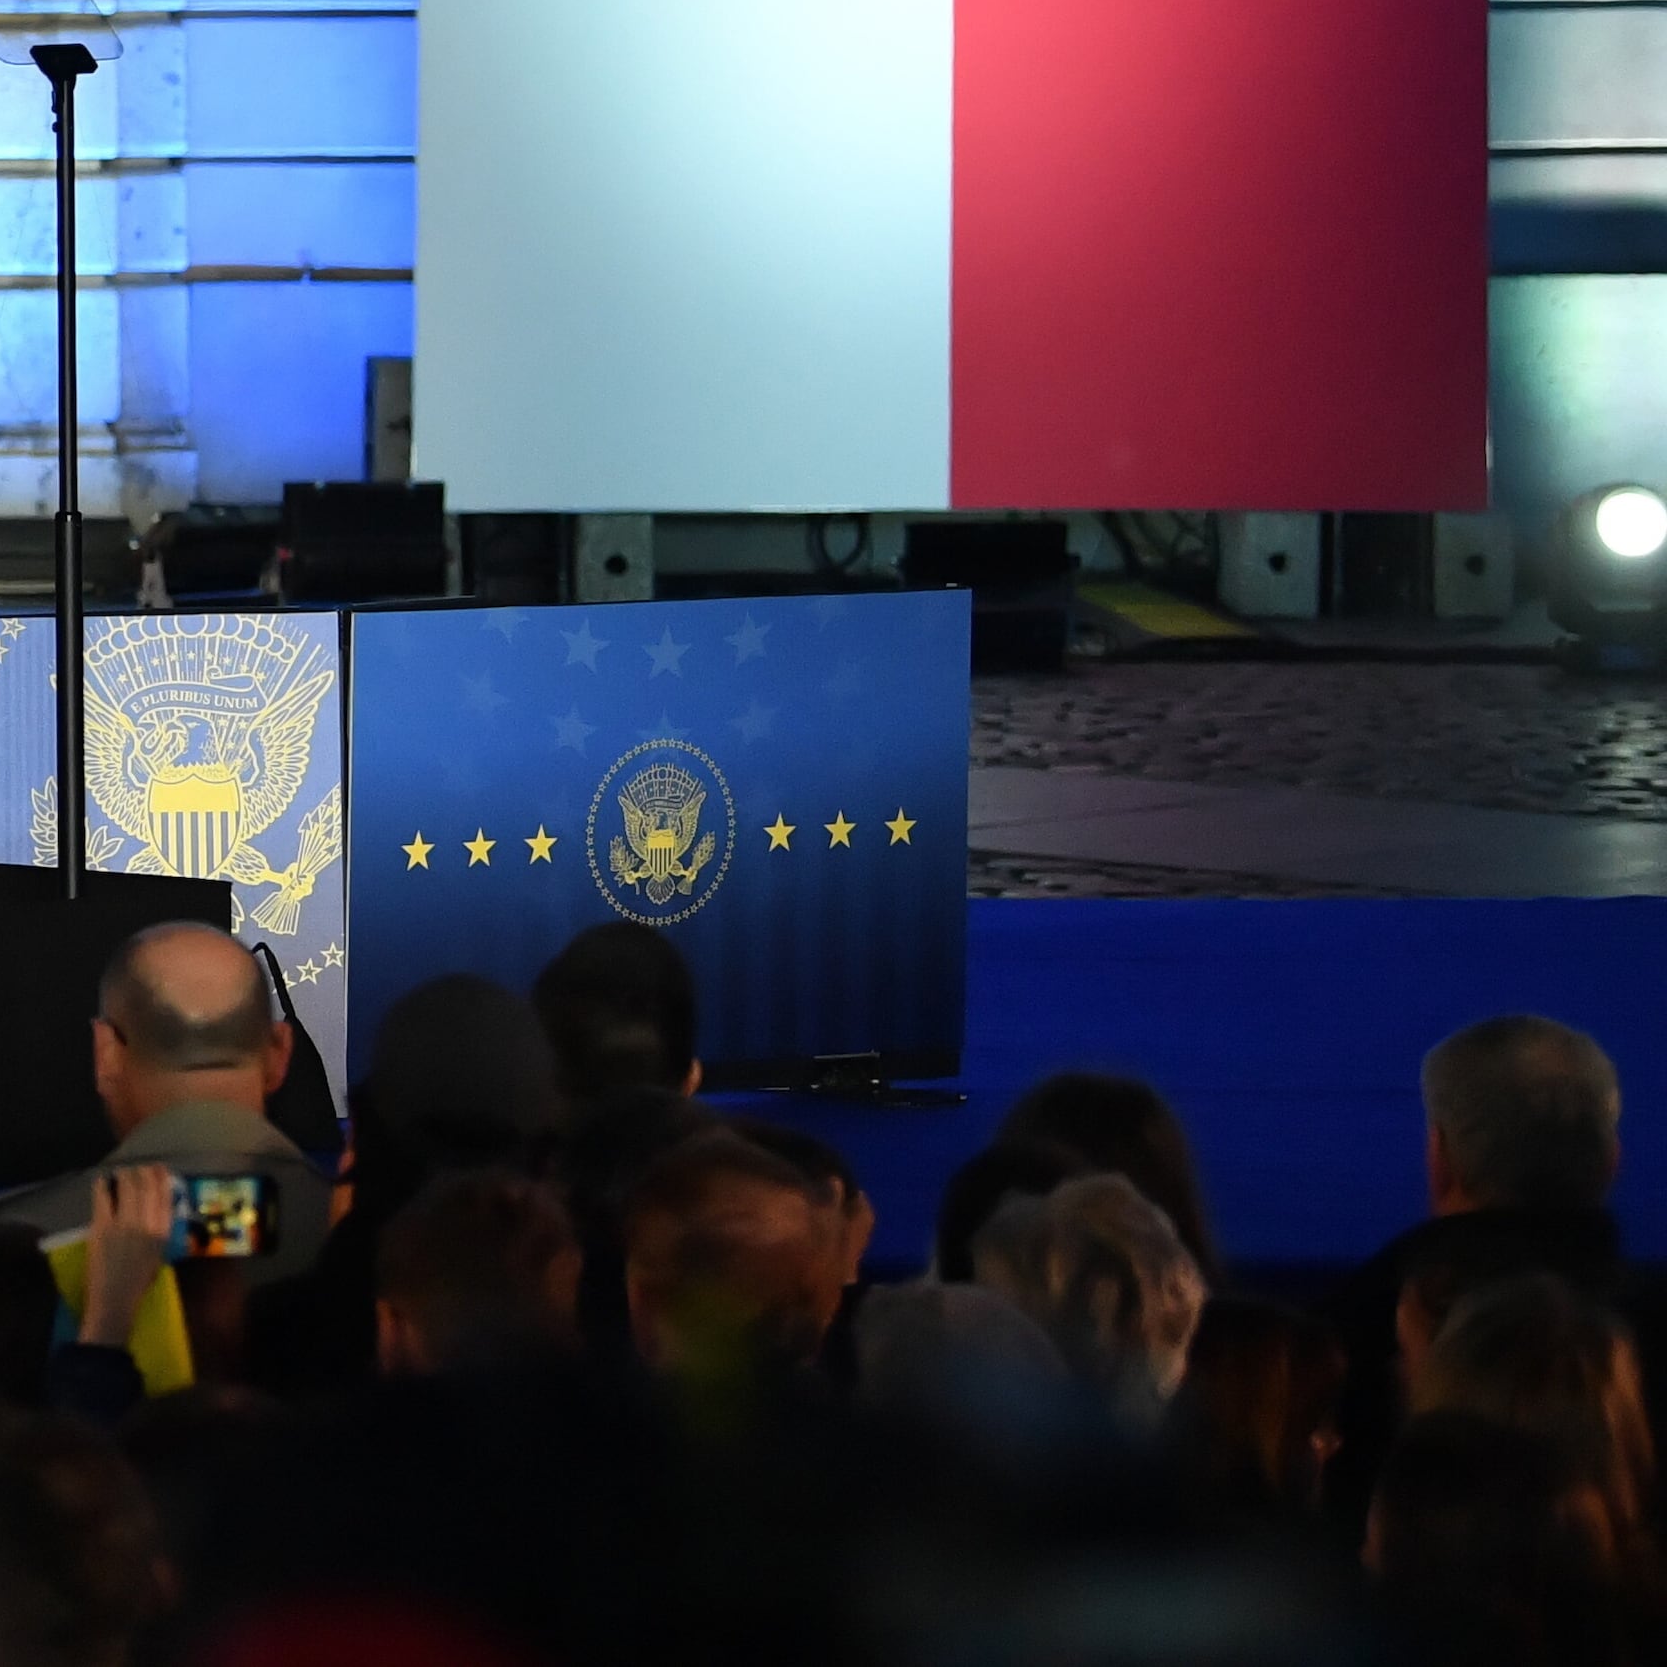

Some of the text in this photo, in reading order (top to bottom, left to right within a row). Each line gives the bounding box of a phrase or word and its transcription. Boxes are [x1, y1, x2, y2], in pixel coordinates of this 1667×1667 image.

[130, 690, 258, 714] E PLURIBUS UNUM
